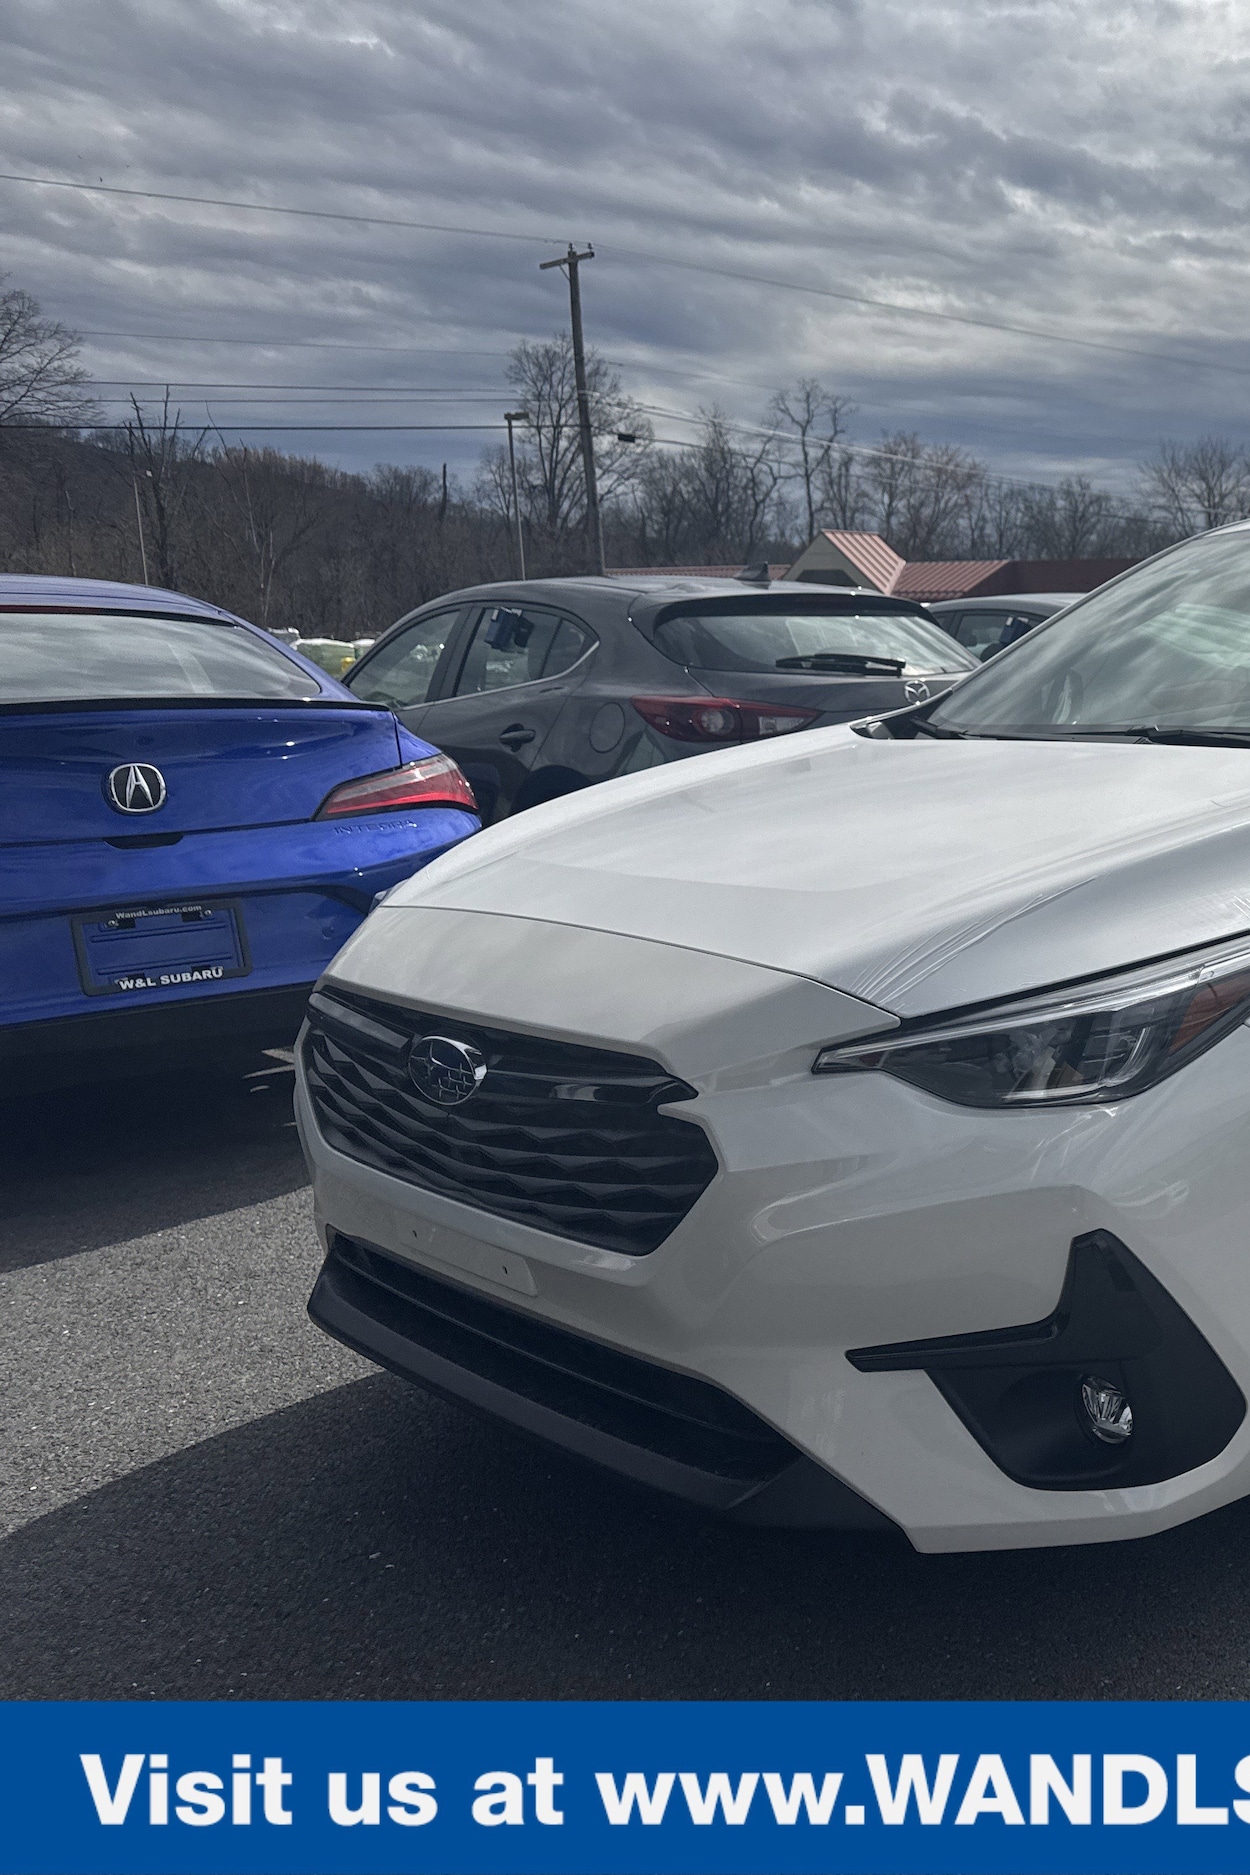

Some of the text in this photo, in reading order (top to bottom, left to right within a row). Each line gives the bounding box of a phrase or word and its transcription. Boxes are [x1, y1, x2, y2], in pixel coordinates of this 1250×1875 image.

[115, 905, 202, 920] WandLsubaru.com
[119, 967, 223, 990] W&L SUBARU
